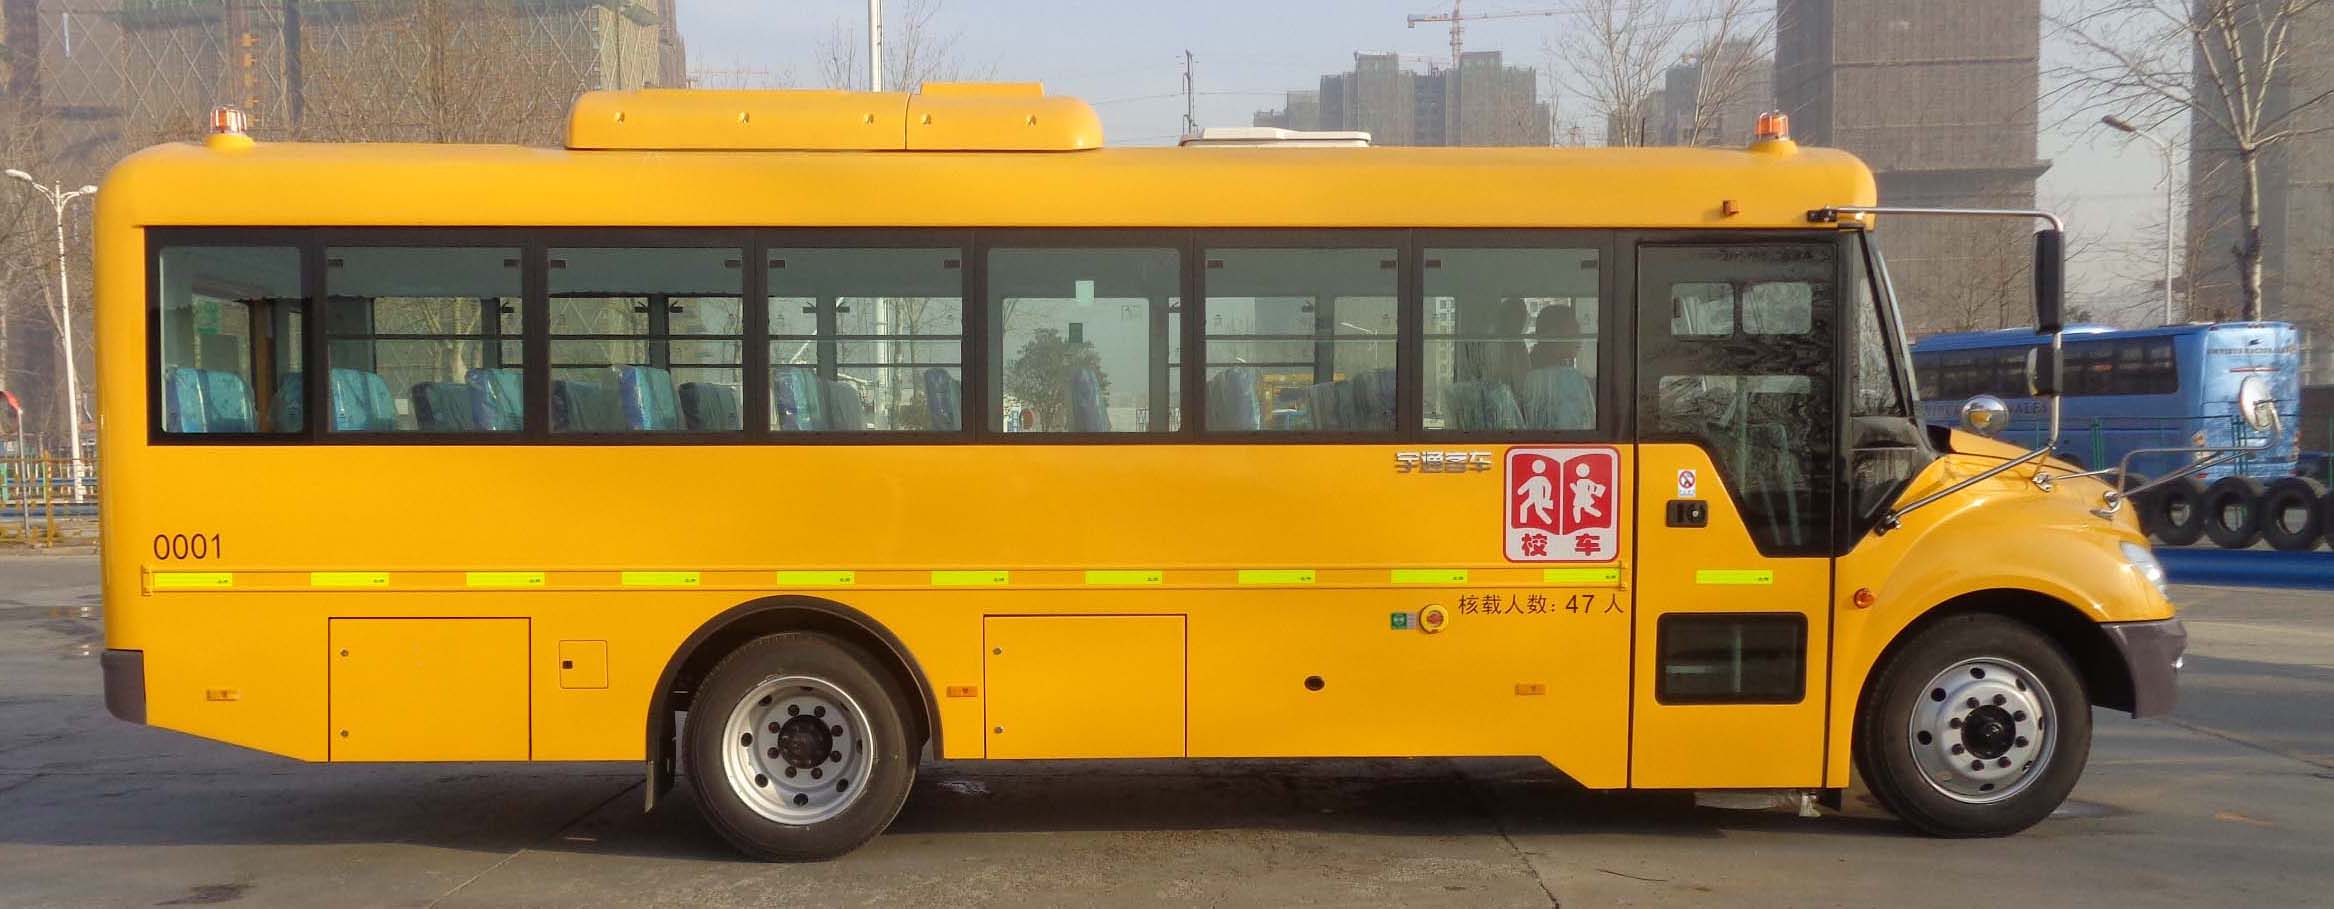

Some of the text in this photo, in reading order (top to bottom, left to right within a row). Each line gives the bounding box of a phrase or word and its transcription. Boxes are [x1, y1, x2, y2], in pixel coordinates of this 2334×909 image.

[1395, 451, 1492, 473] 宇通客车
[153, 533, 221, 560] 0001
[1565, 594, 1595, 614] 47
